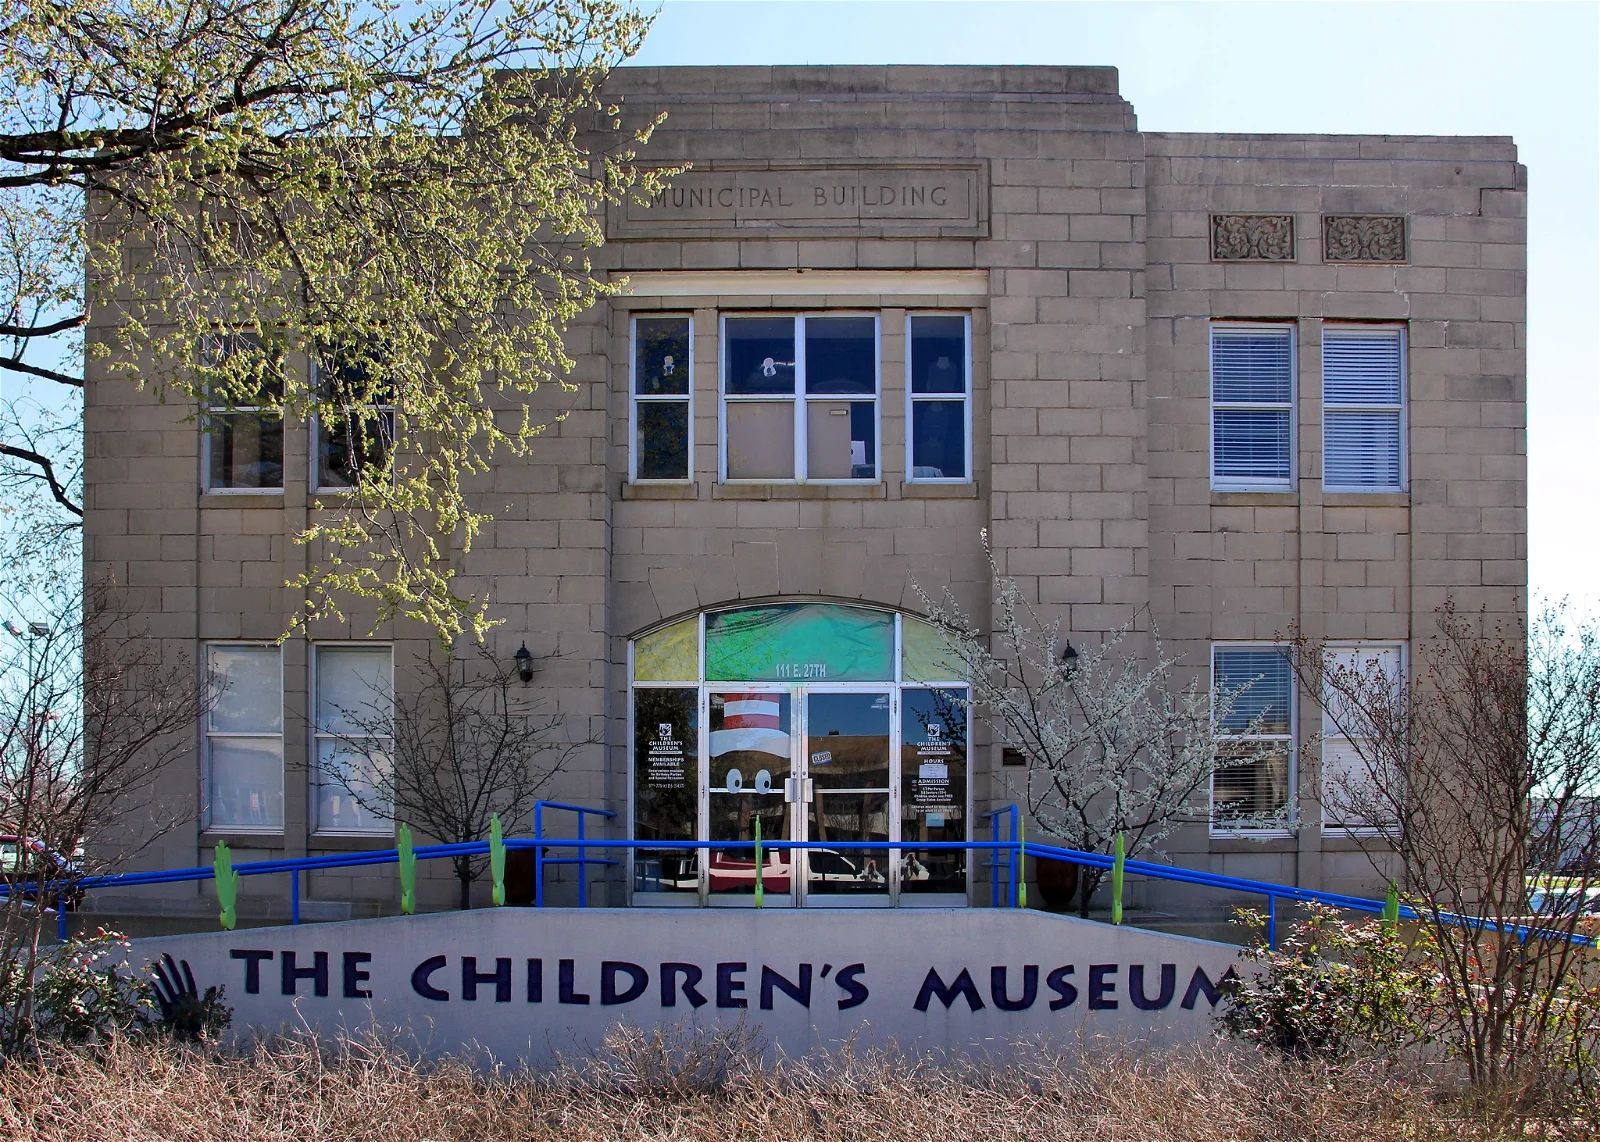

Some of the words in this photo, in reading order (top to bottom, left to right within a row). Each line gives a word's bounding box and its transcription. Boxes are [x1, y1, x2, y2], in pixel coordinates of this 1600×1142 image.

[649, 187, 792, 208] MUNICIPAL
[814, 186, 947, 205] BUILDING
[776, 664, 790, 677] 111
[794, 664, 801, 677] E.
[804, 664, 826, 677] 27TH
[230, 949, 373, 998] THE
[410, 955, 869, 1010] CHILDREN'S
[912, 963, 1245, 1012] MUSEUM
